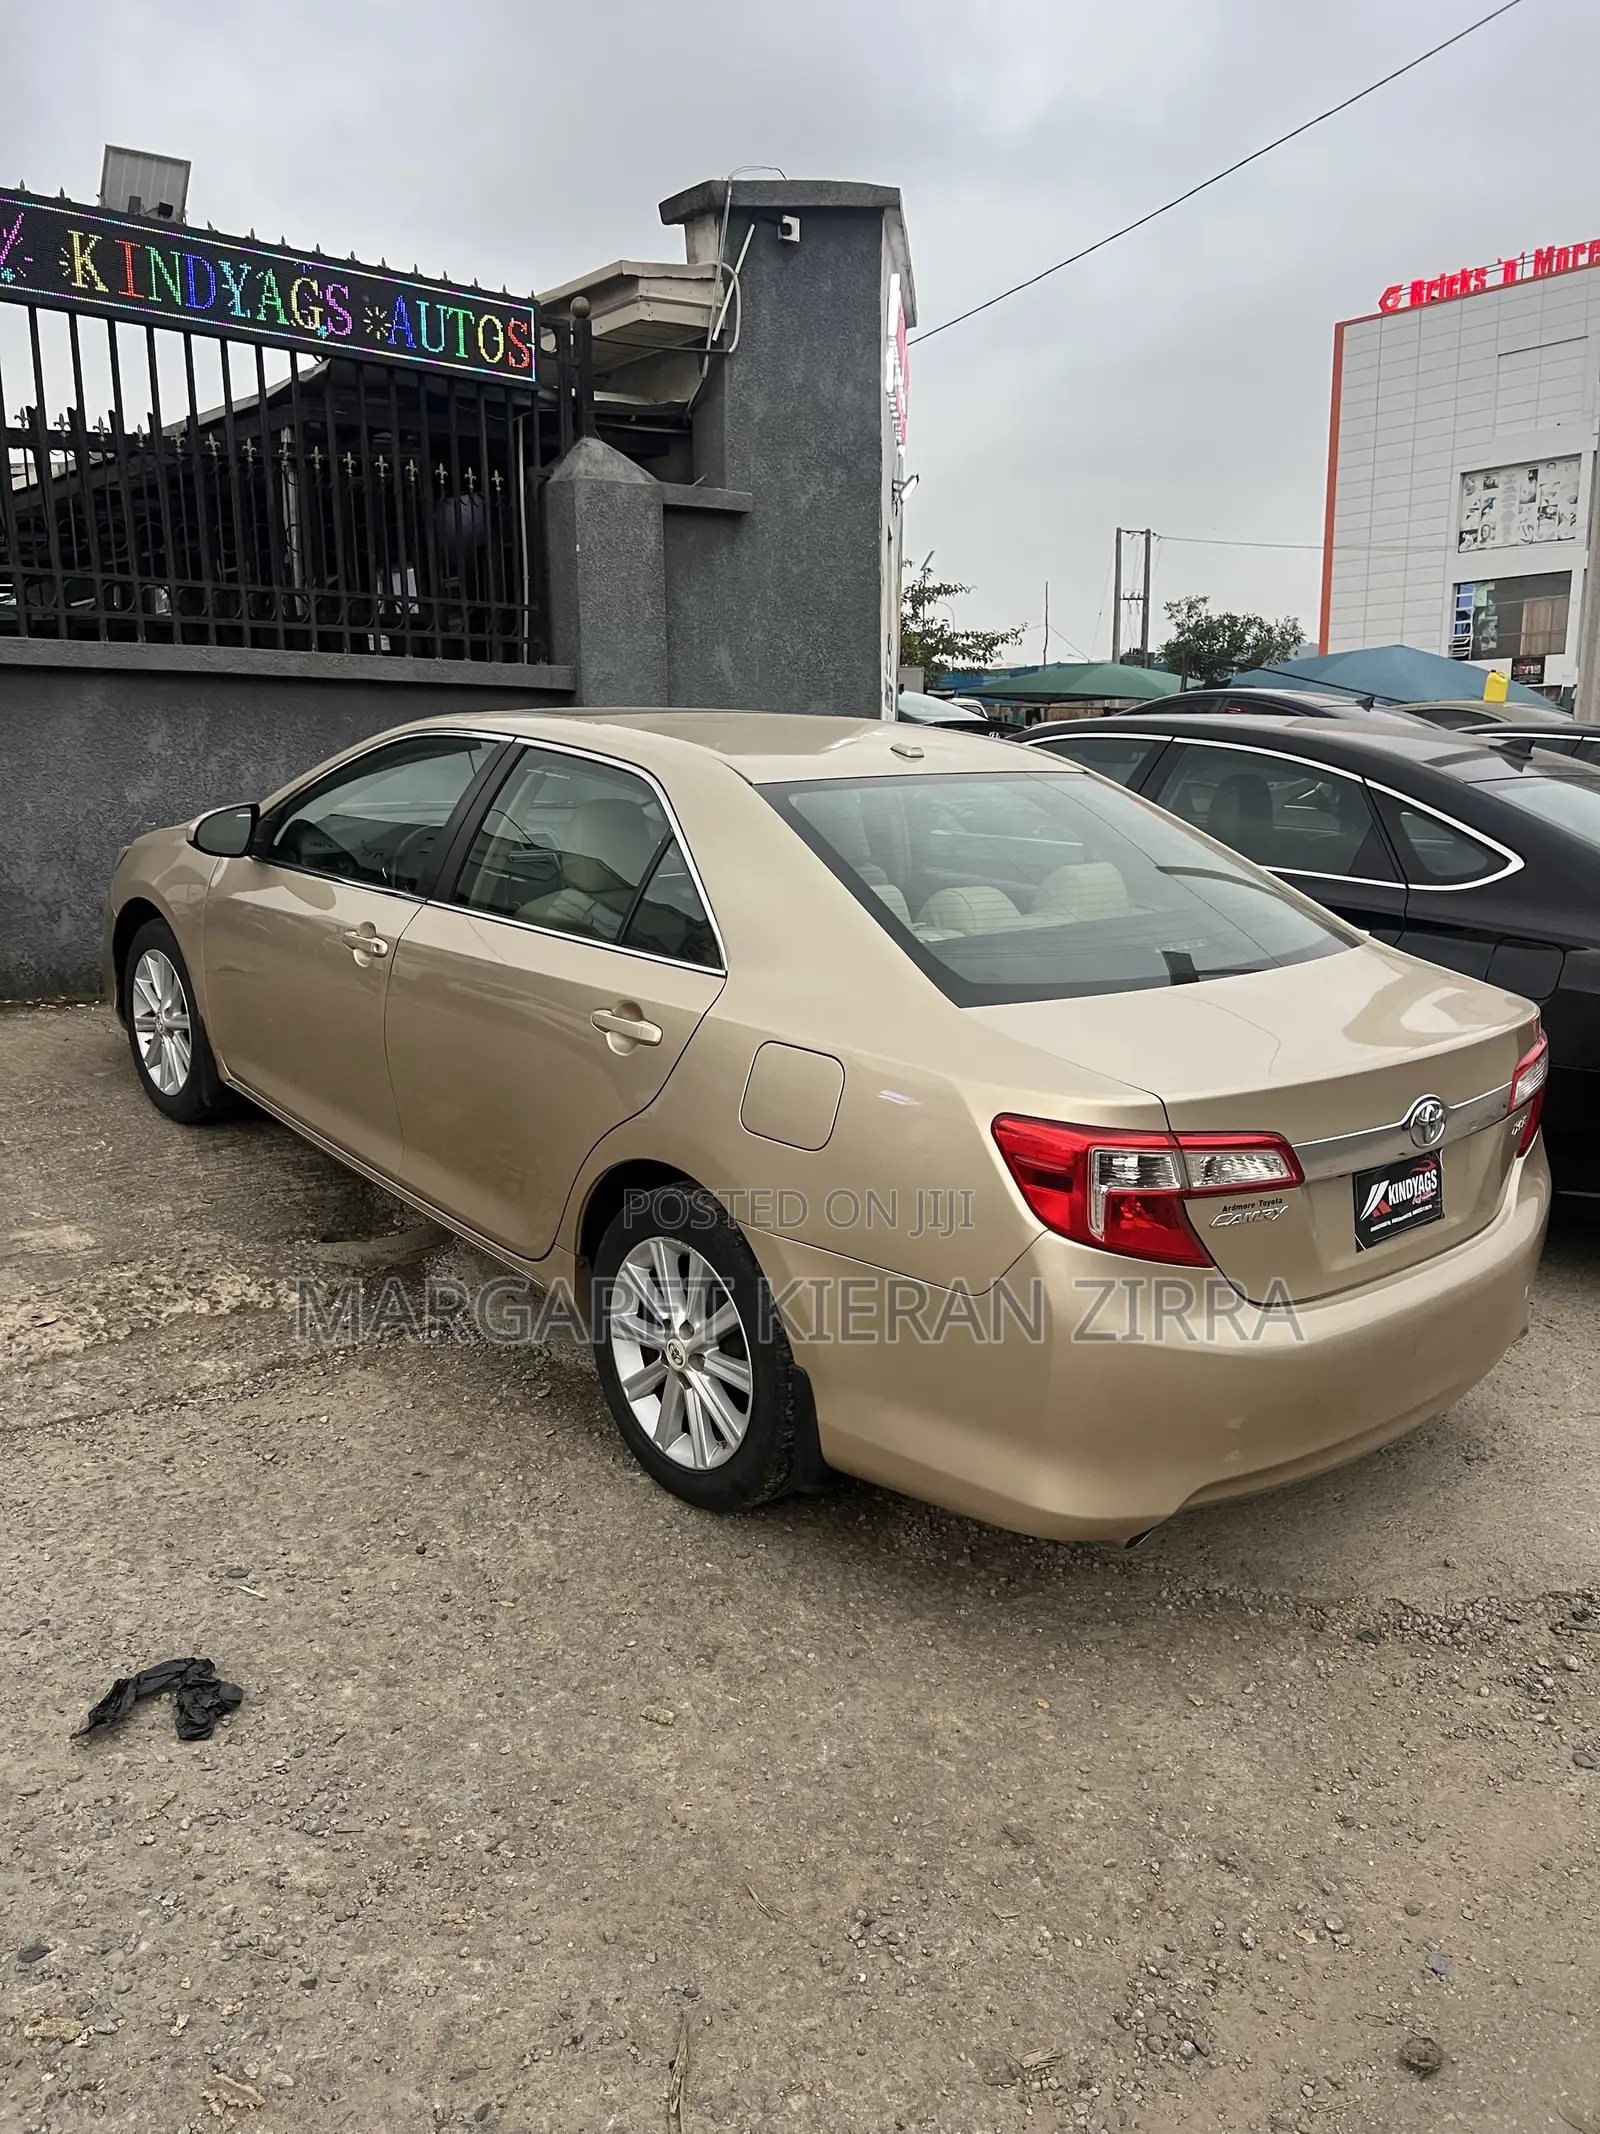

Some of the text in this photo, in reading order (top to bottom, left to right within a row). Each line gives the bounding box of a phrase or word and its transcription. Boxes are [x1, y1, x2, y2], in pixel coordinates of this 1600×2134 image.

[66, 229, 530, 370] KINDYAGS AUTOS
[1409, 266, 1488, 308] Bricks
[1222, 1197, 1283, 1212] Ardmore Toyota
[1387, 1168, 1438, 1206] KINDYAGS
[1209, 1204, 1289, 1228] CAMRY
